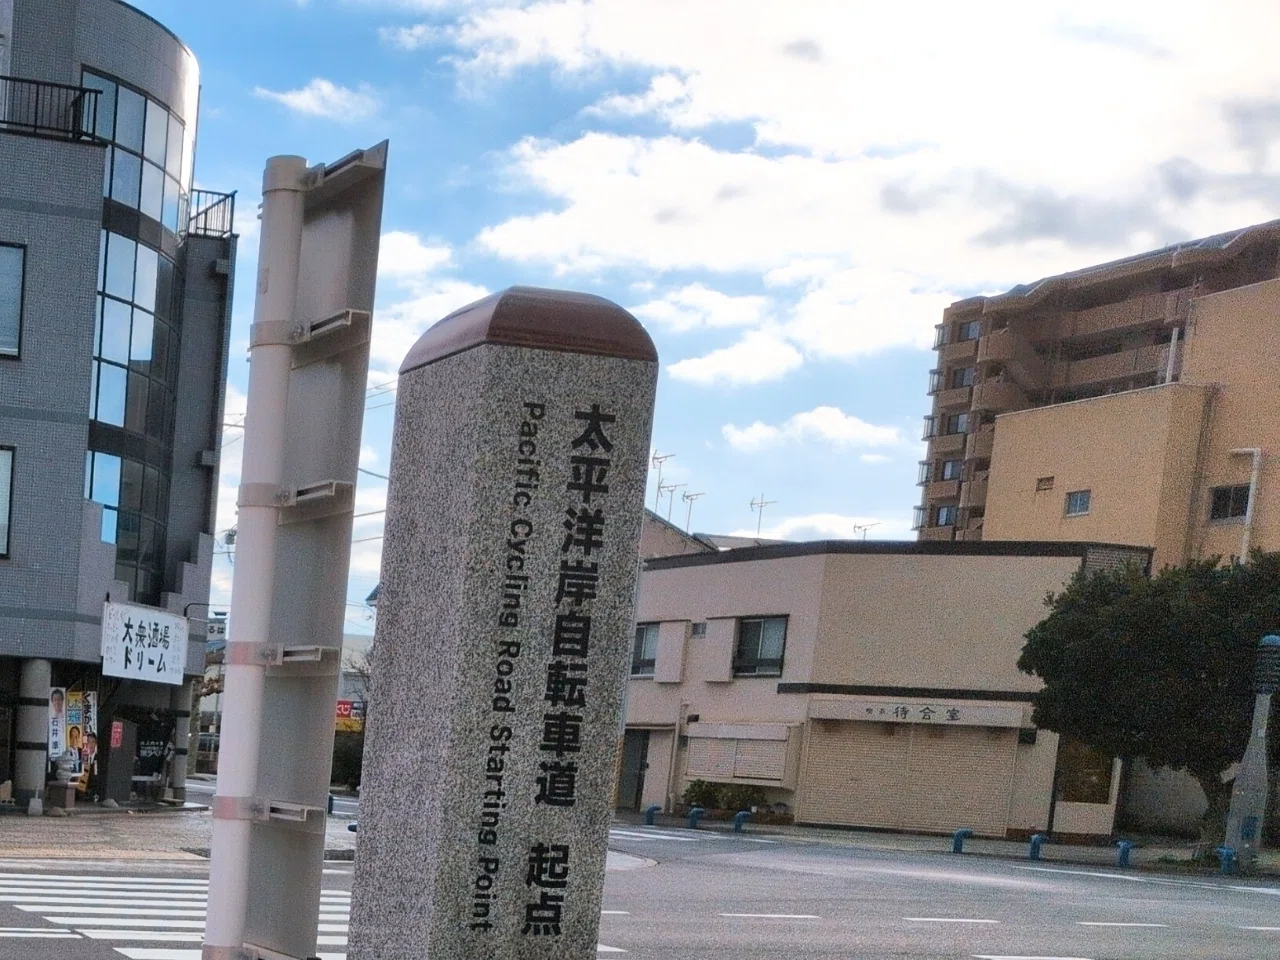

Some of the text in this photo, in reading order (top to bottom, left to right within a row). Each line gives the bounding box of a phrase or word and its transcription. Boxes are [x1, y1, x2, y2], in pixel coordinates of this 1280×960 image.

[122, 617, 170, 650] 大衆酒場
[124, 646, 167, 673] ドリーム
[471, 402, 546, 933] Pacific Cycling Road Starting Point
[521, 403, 616, 936] 太平洋岸自転車道 起点
[892, 705, 960, 721] 待合室
